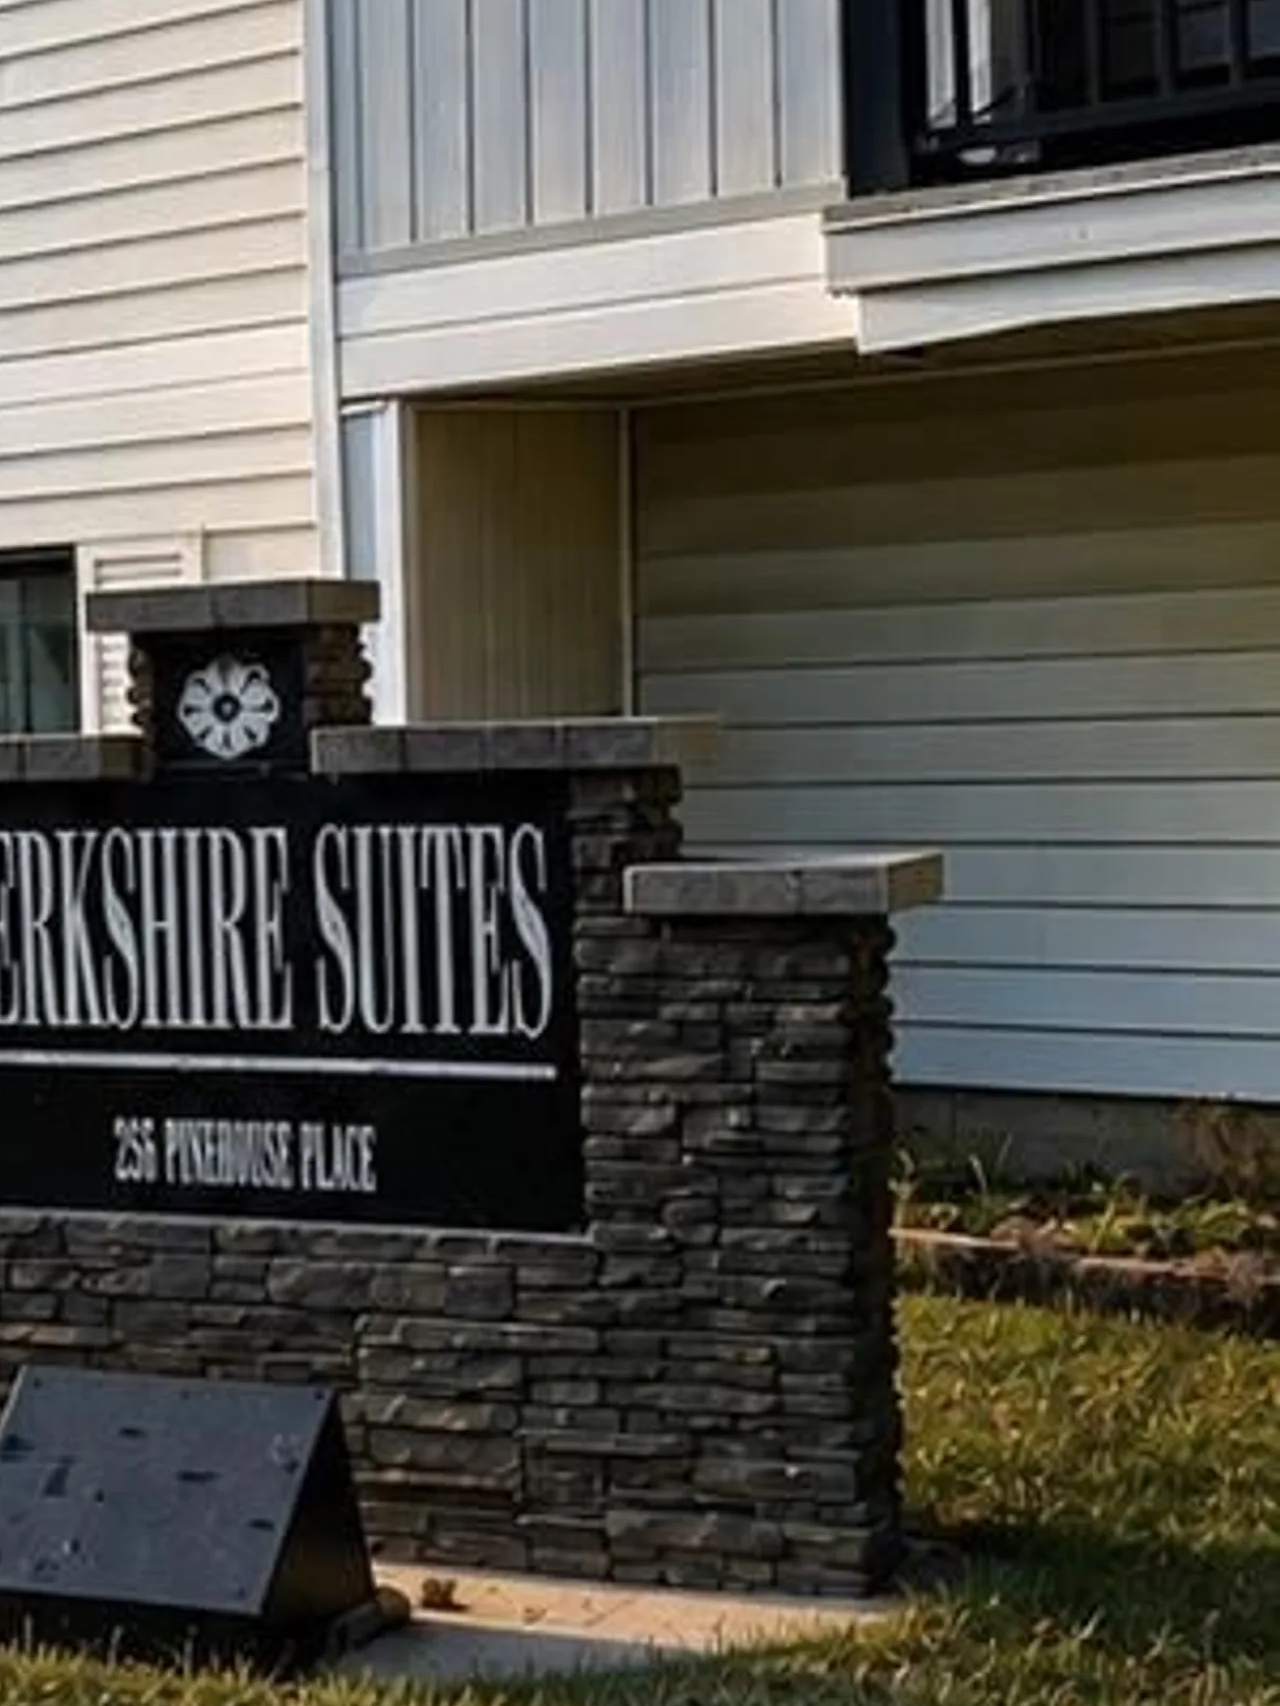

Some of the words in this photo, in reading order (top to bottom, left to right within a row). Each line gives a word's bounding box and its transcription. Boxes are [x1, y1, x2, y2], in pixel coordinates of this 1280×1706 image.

[313, 822, 554, 1040] SUITES
[164, 1117, 295, 1190] PINEHOUSE
[299, 1122, 378, 1192] PLACE
